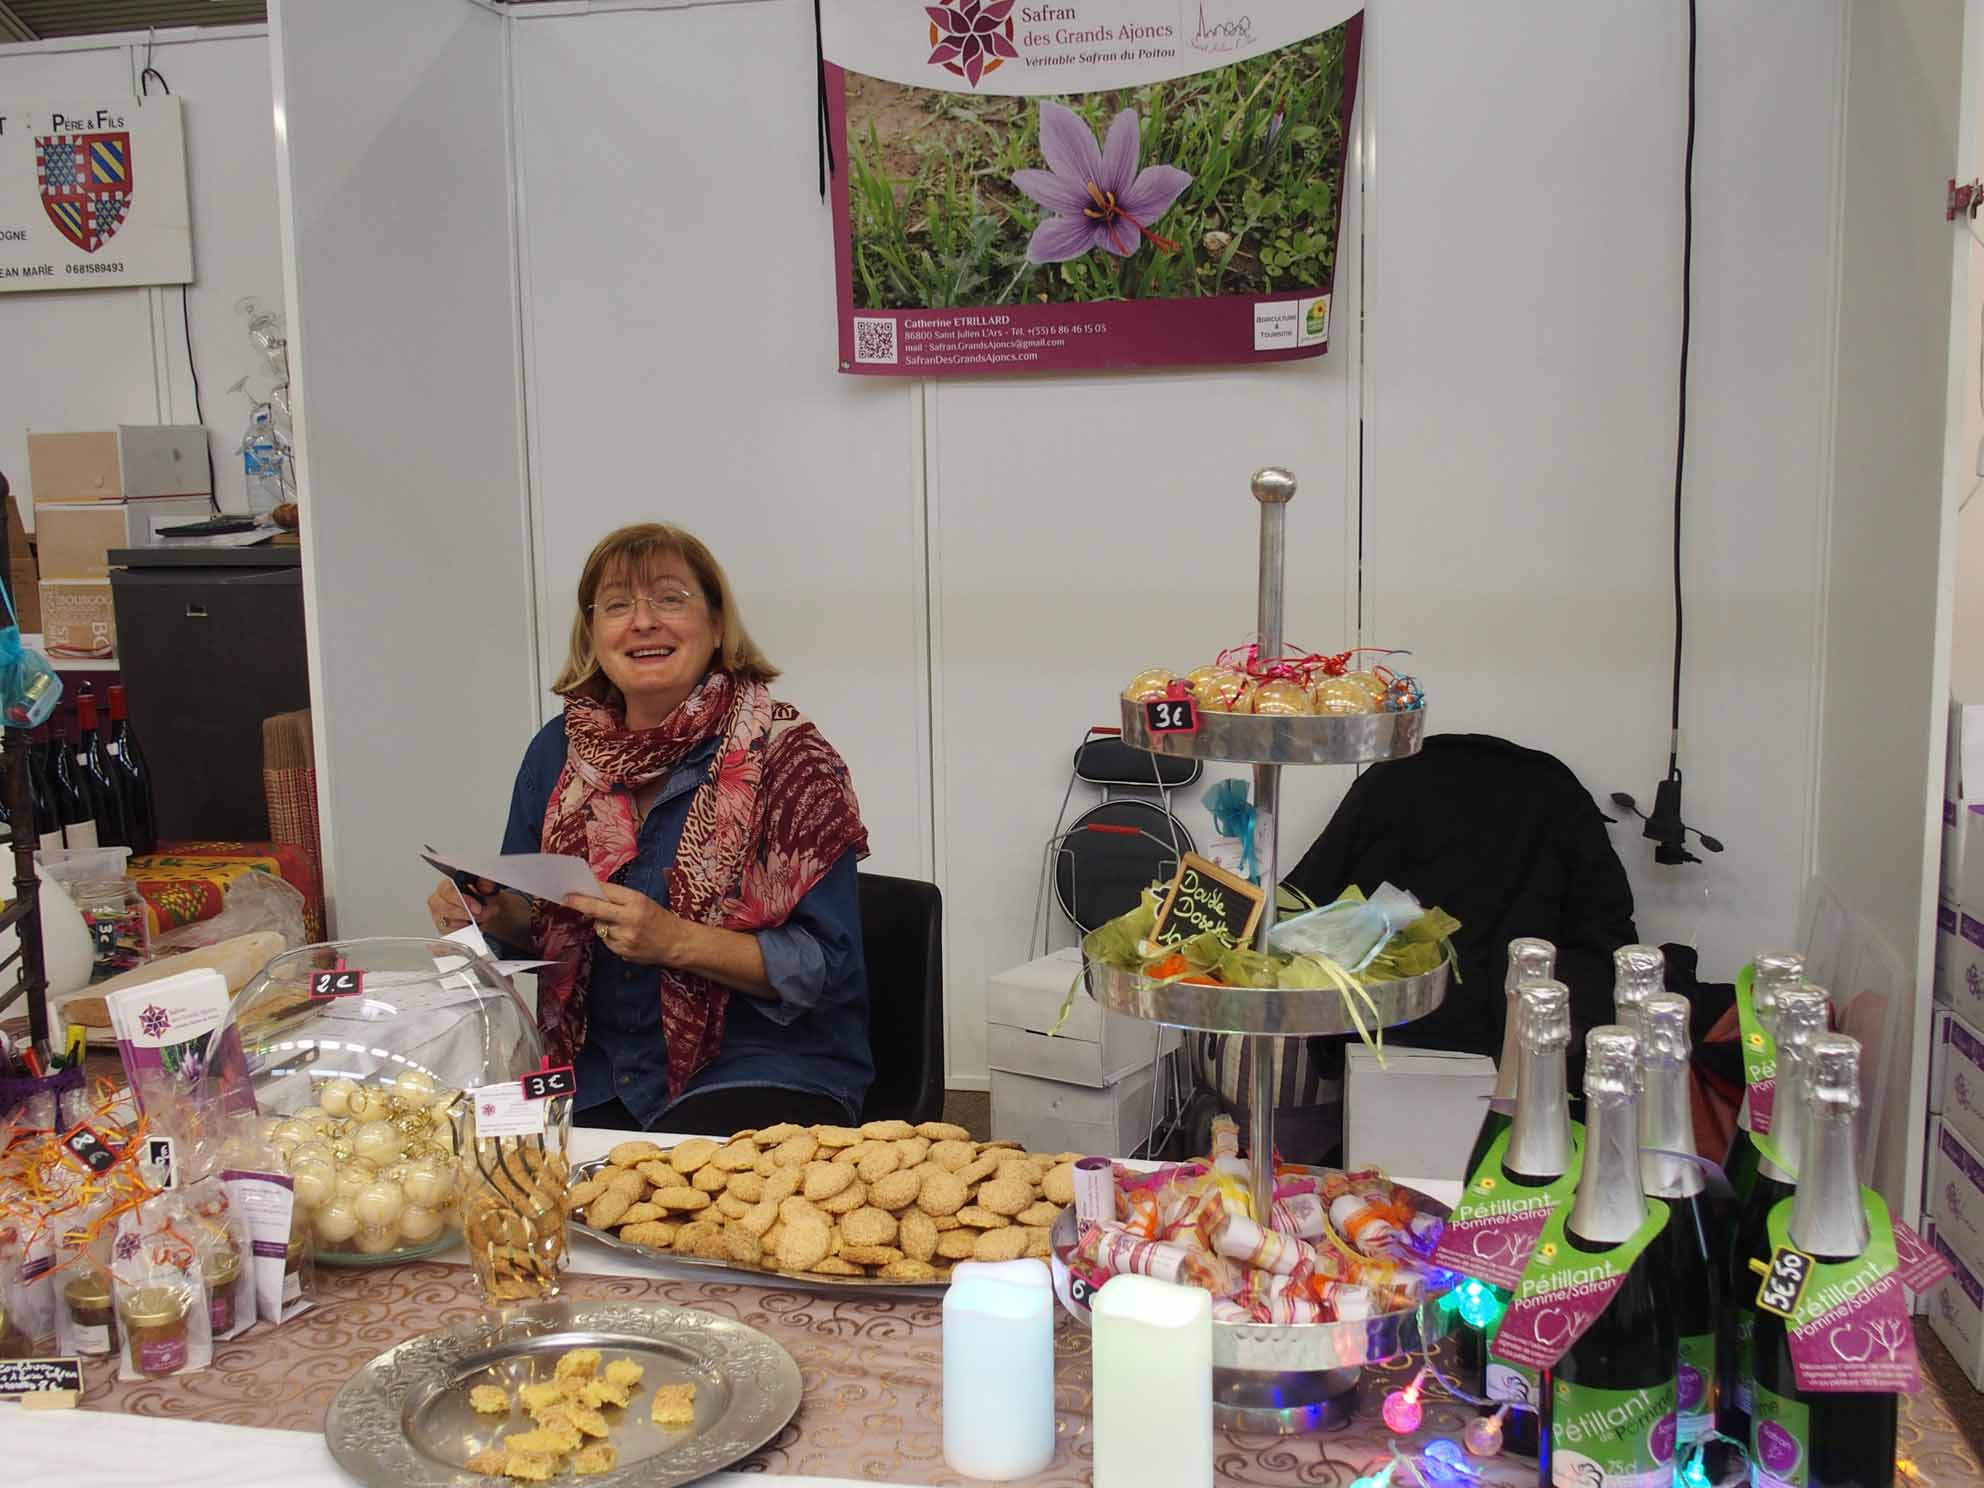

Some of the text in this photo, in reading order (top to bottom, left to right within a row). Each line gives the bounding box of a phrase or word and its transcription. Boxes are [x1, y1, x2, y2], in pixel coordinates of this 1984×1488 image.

[1022, 5, 1076, 23] Safran
[1023, 23, 1173, 47] des Grands Ajoncs
[1079, 52, 1117, 65] Safran
[1120, 50, 1135, 61] du
[1138, 48, 1176, 60] Poitou
[87, 120, 95, 130] &
[904, 315, 1010, 329] Catherine ETRILLARD
[934, 330, 955, 340] Saint
[957, 330, 980, 340] Julien
[1155, 703, 1184, 729] 3€
[1459, 1191, 1550, 1221] Pétillant
[1522, 1260, 1614, 1298] Pétillant
[1514, 1277, 1617, 1311] Pomme/Safran
[1795, 1258, 1890, 1328] Pétillant
[1792, 1273, 1898, 1341] Pomme/Safran
[1552, 1388, 1651, 1447] Pétillant
